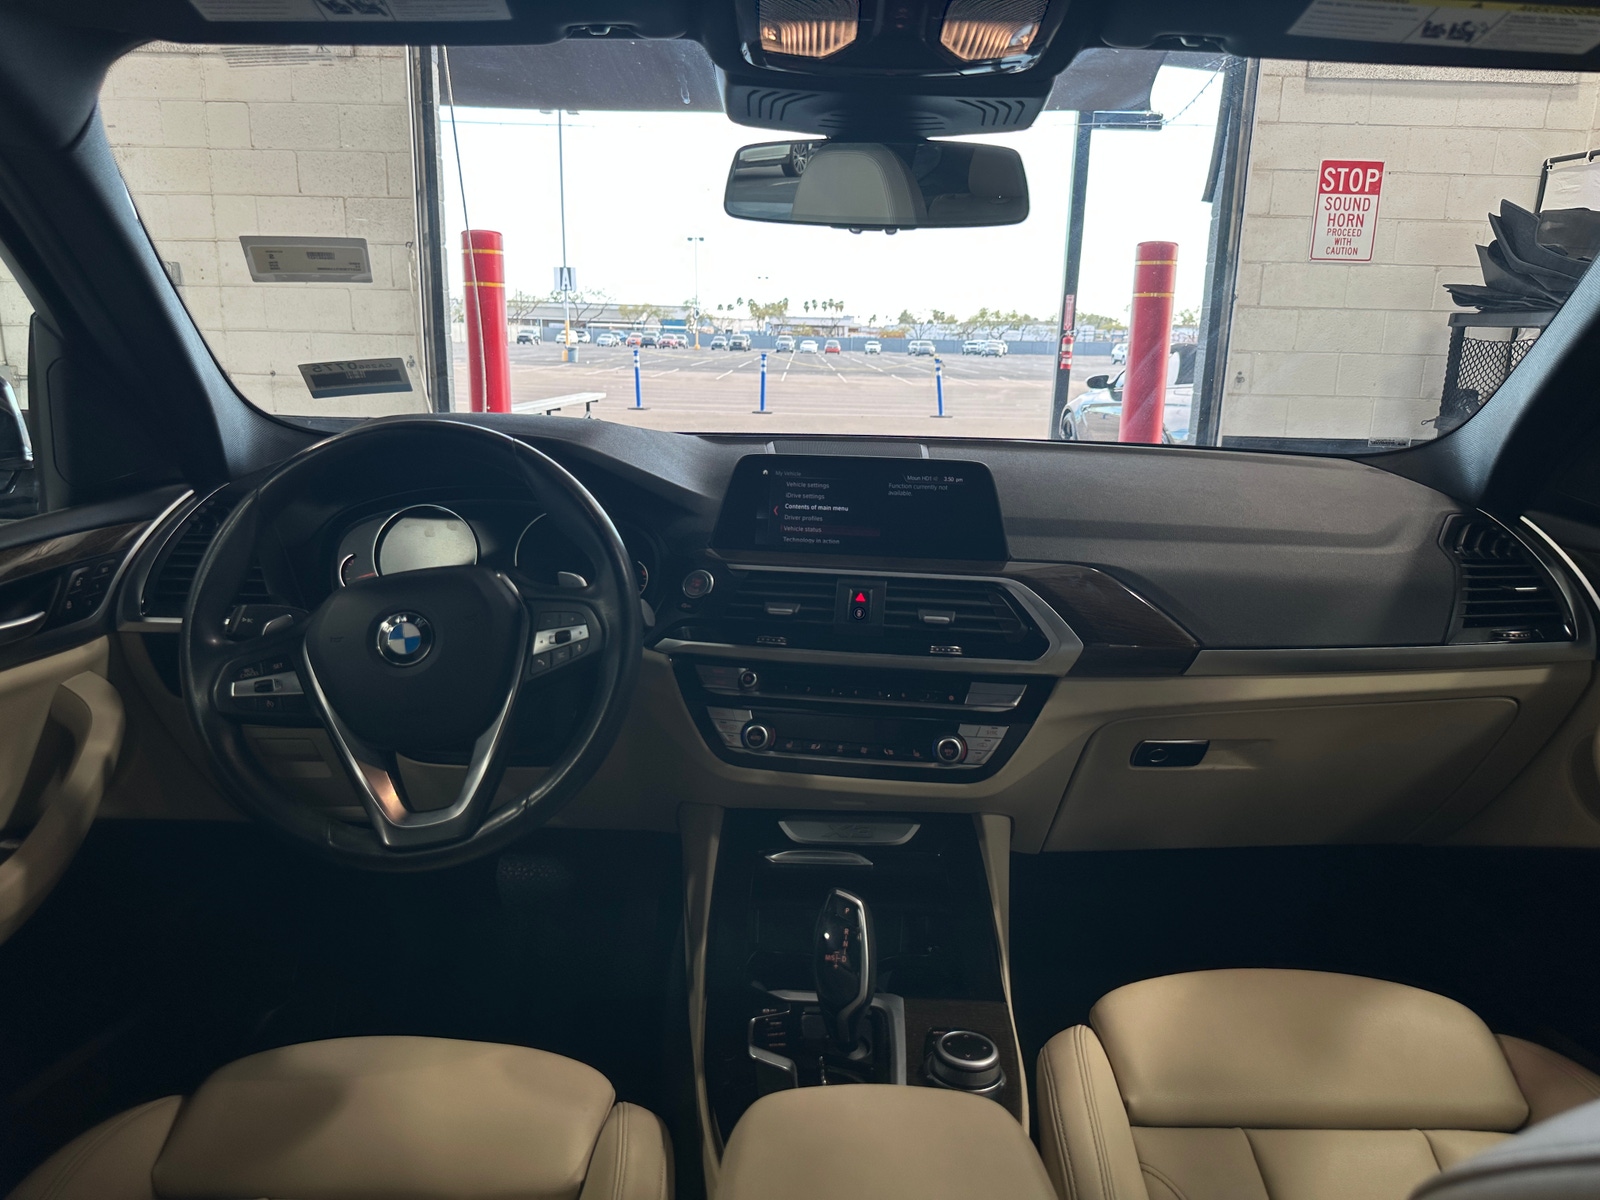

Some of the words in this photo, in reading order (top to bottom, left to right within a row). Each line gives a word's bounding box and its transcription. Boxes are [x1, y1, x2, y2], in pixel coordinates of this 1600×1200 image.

[1321, 167, 1380, 192] STOP
[1324, 196, 1371, 212] SOUND
[1327, 213, 1365, 228] HORN
[1326, 228, 1362, 237] PROCEED
[1334, 237, 1352, 246] WITH
[1325, 246, 1359, 255] CAUTION
[560, 267, 572, 290] A
[807, 482, 830, 490] settings
[913, 483, 938, 491] currently
[802, 493, 825, 501] settings
[784, 502, 810, 510] Contents
[810, 503, 817, 511] of
[782, 536, 815, 544] Technology
[844, 927, 850, 935] R
[842, 940, 849, 948] N
[841, 955, 847, 963] D
